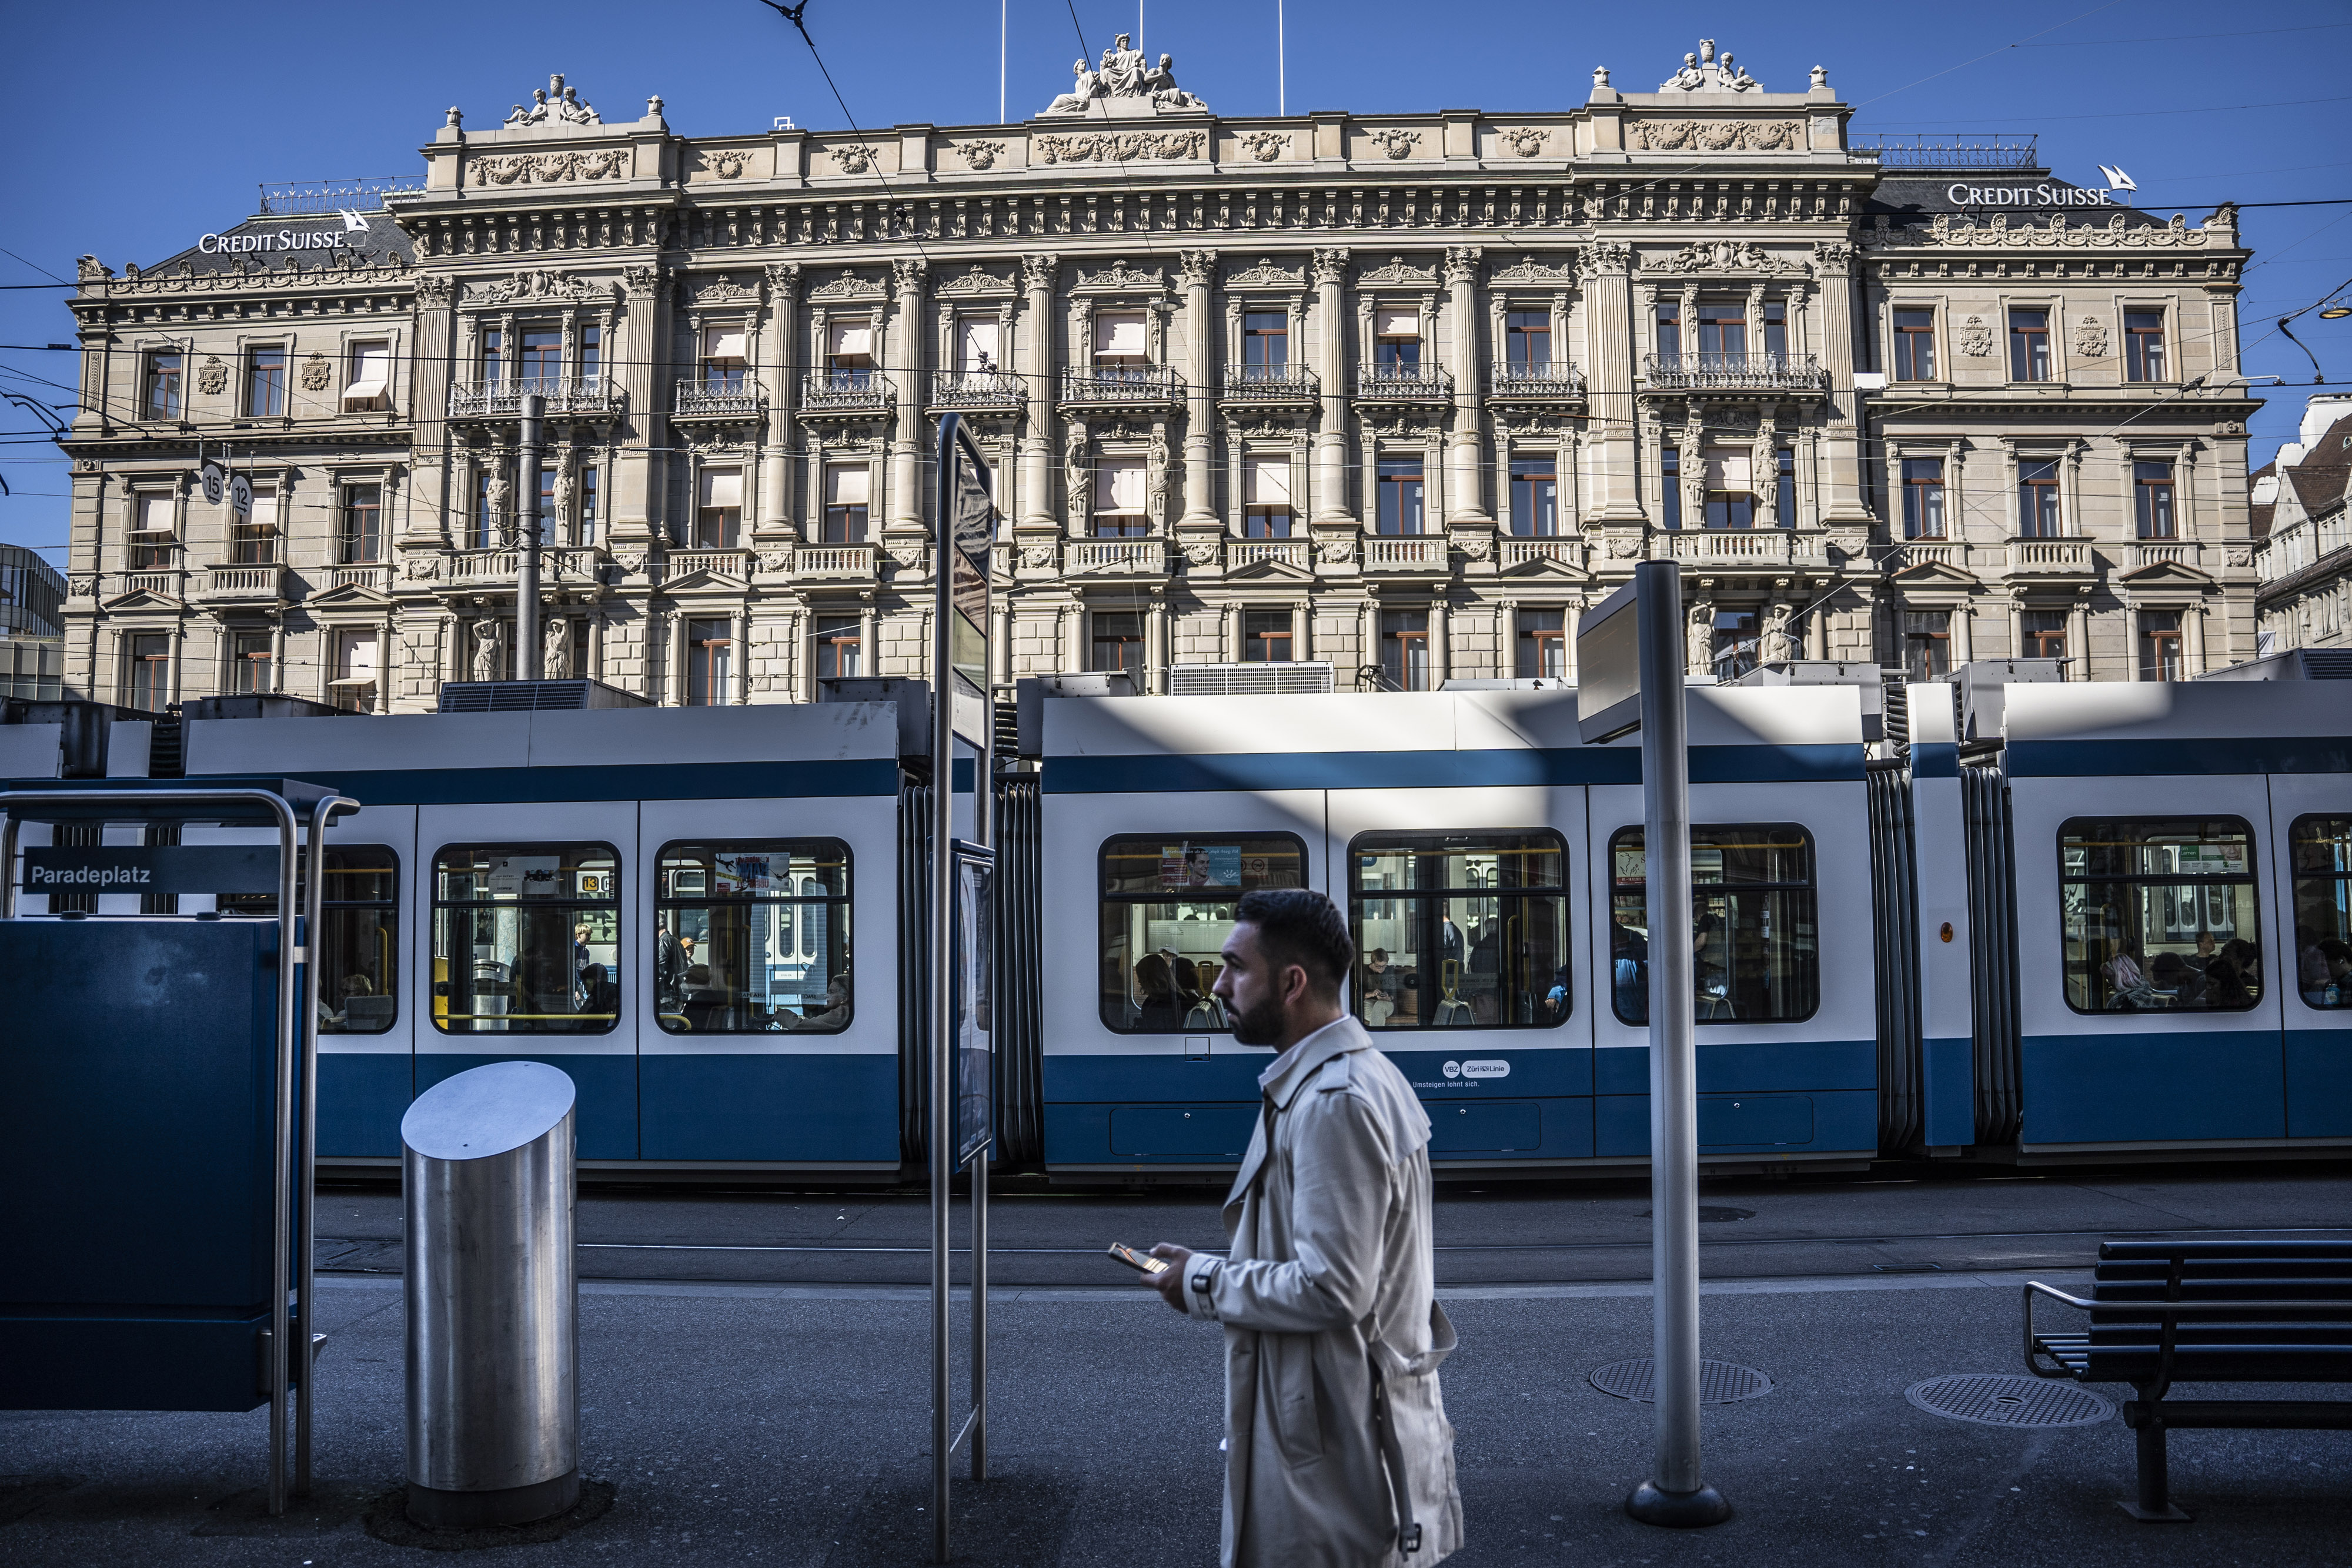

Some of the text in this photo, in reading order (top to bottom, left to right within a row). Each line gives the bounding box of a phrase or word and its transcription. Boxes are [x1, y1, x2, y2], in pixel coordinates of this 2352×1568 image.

[206, 475, 220, 495] 15
[235, 486, 248, 506] 12
[32, 865, 151, 887] Paradeplatz
[584, 878, 597, 888] 13
